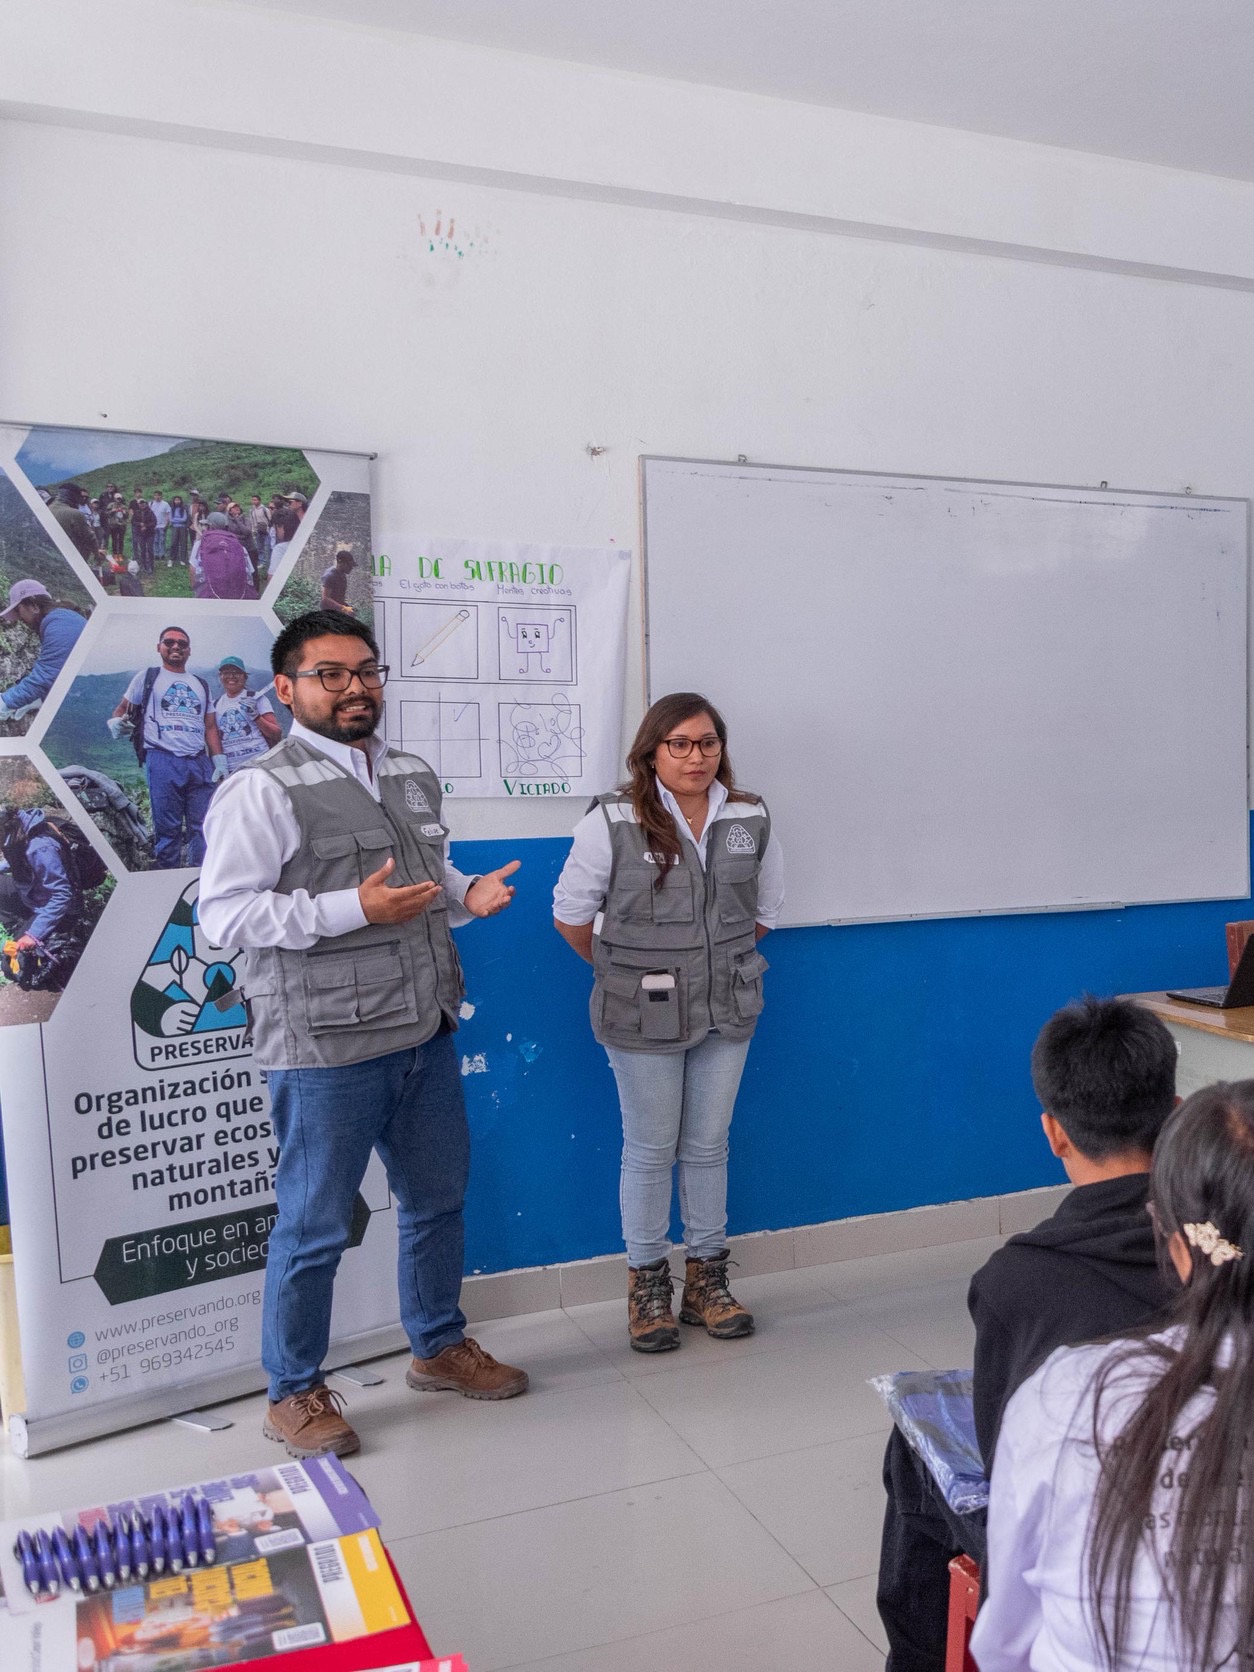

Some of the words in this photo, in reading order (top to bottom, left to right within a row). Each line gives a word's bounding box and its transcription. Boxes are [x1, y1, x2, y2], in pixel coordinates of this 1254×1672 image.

[463, 558, 564, 585] SUFRAGIO
[150, 1033, 254, 1062] PRESERVA
[74, 1068, 252, 1115] Organización
[97, 1116, 131, 1140] de
[140, 1104, 207, 1133] lucro
[215, 1095, 264, 1123] que
[71, 1132, 205, 1180] preservar
[214, 1120, 277, 1146] ecos
[132, 1150, 260, 1190] naturales
[267, 1146, 281, 1169] y
[122, 1227, 217, 1263] Enfoque
[223, 1220, 249, 1240] en
[255, 1213, 279, 1233] am
[185, 1257, 198, 1280] y
[95, 1289, 261, 1342] www.preservando.org
[96, 1316, 239, 1365] @preservando_org
[99, 1363, 130, 1383] +51
[140, 1335, 235, 1374] 969342545
